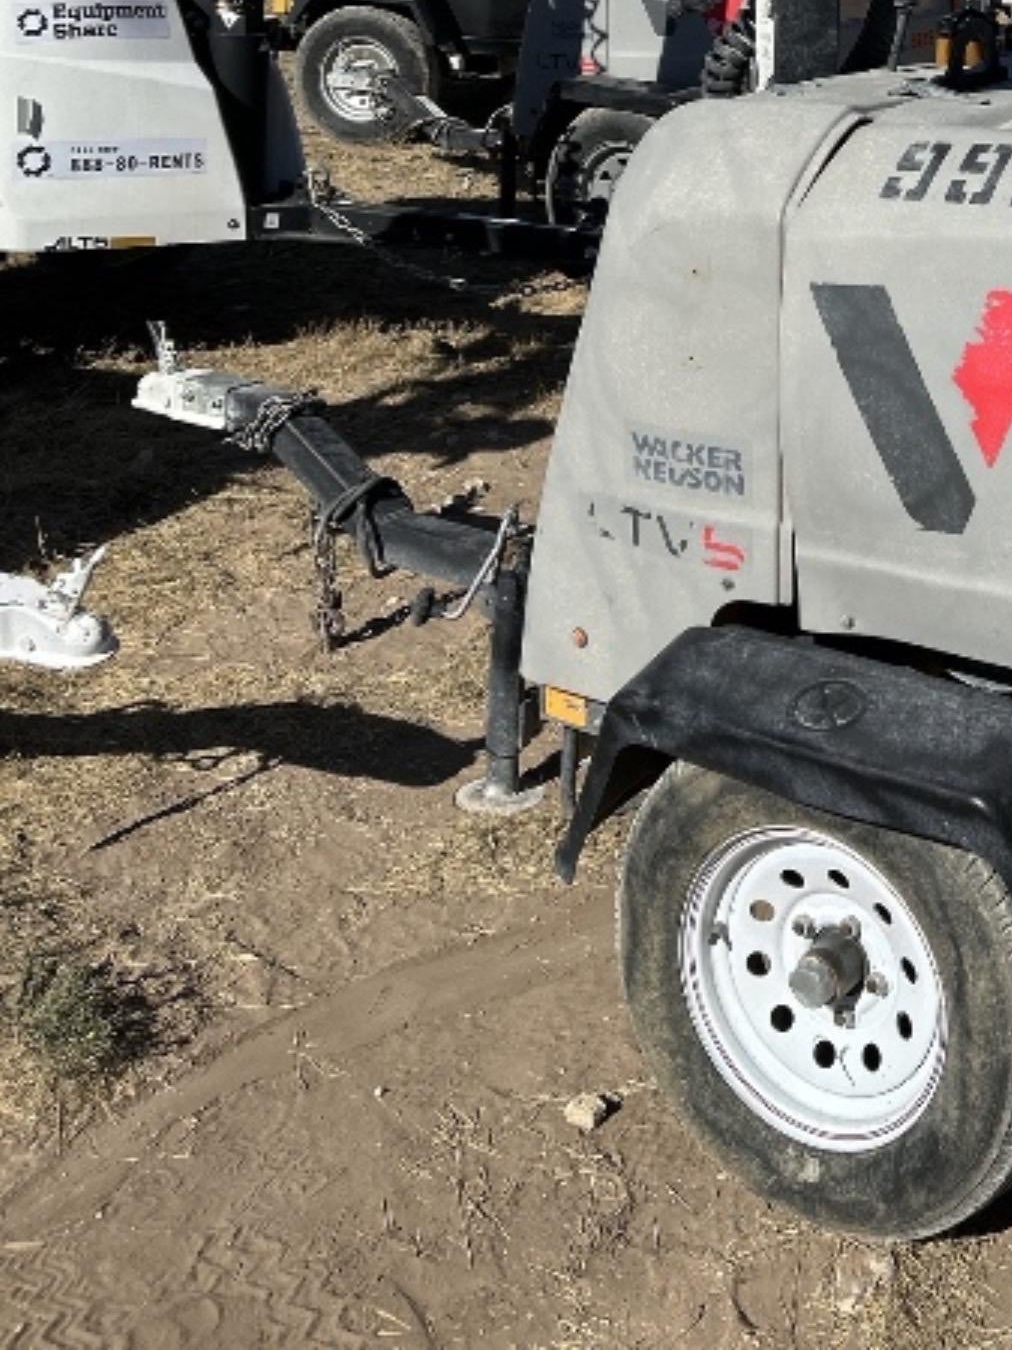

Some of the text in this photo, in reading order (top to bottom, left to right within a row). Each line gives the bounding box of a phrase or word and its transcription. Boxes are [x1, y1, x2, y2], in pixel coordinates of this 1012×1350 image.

[52, 3, 166, 22] Equipment
[631, 431, 743, 472] WACKER
[633, 455, 745, 496] NEUSON
